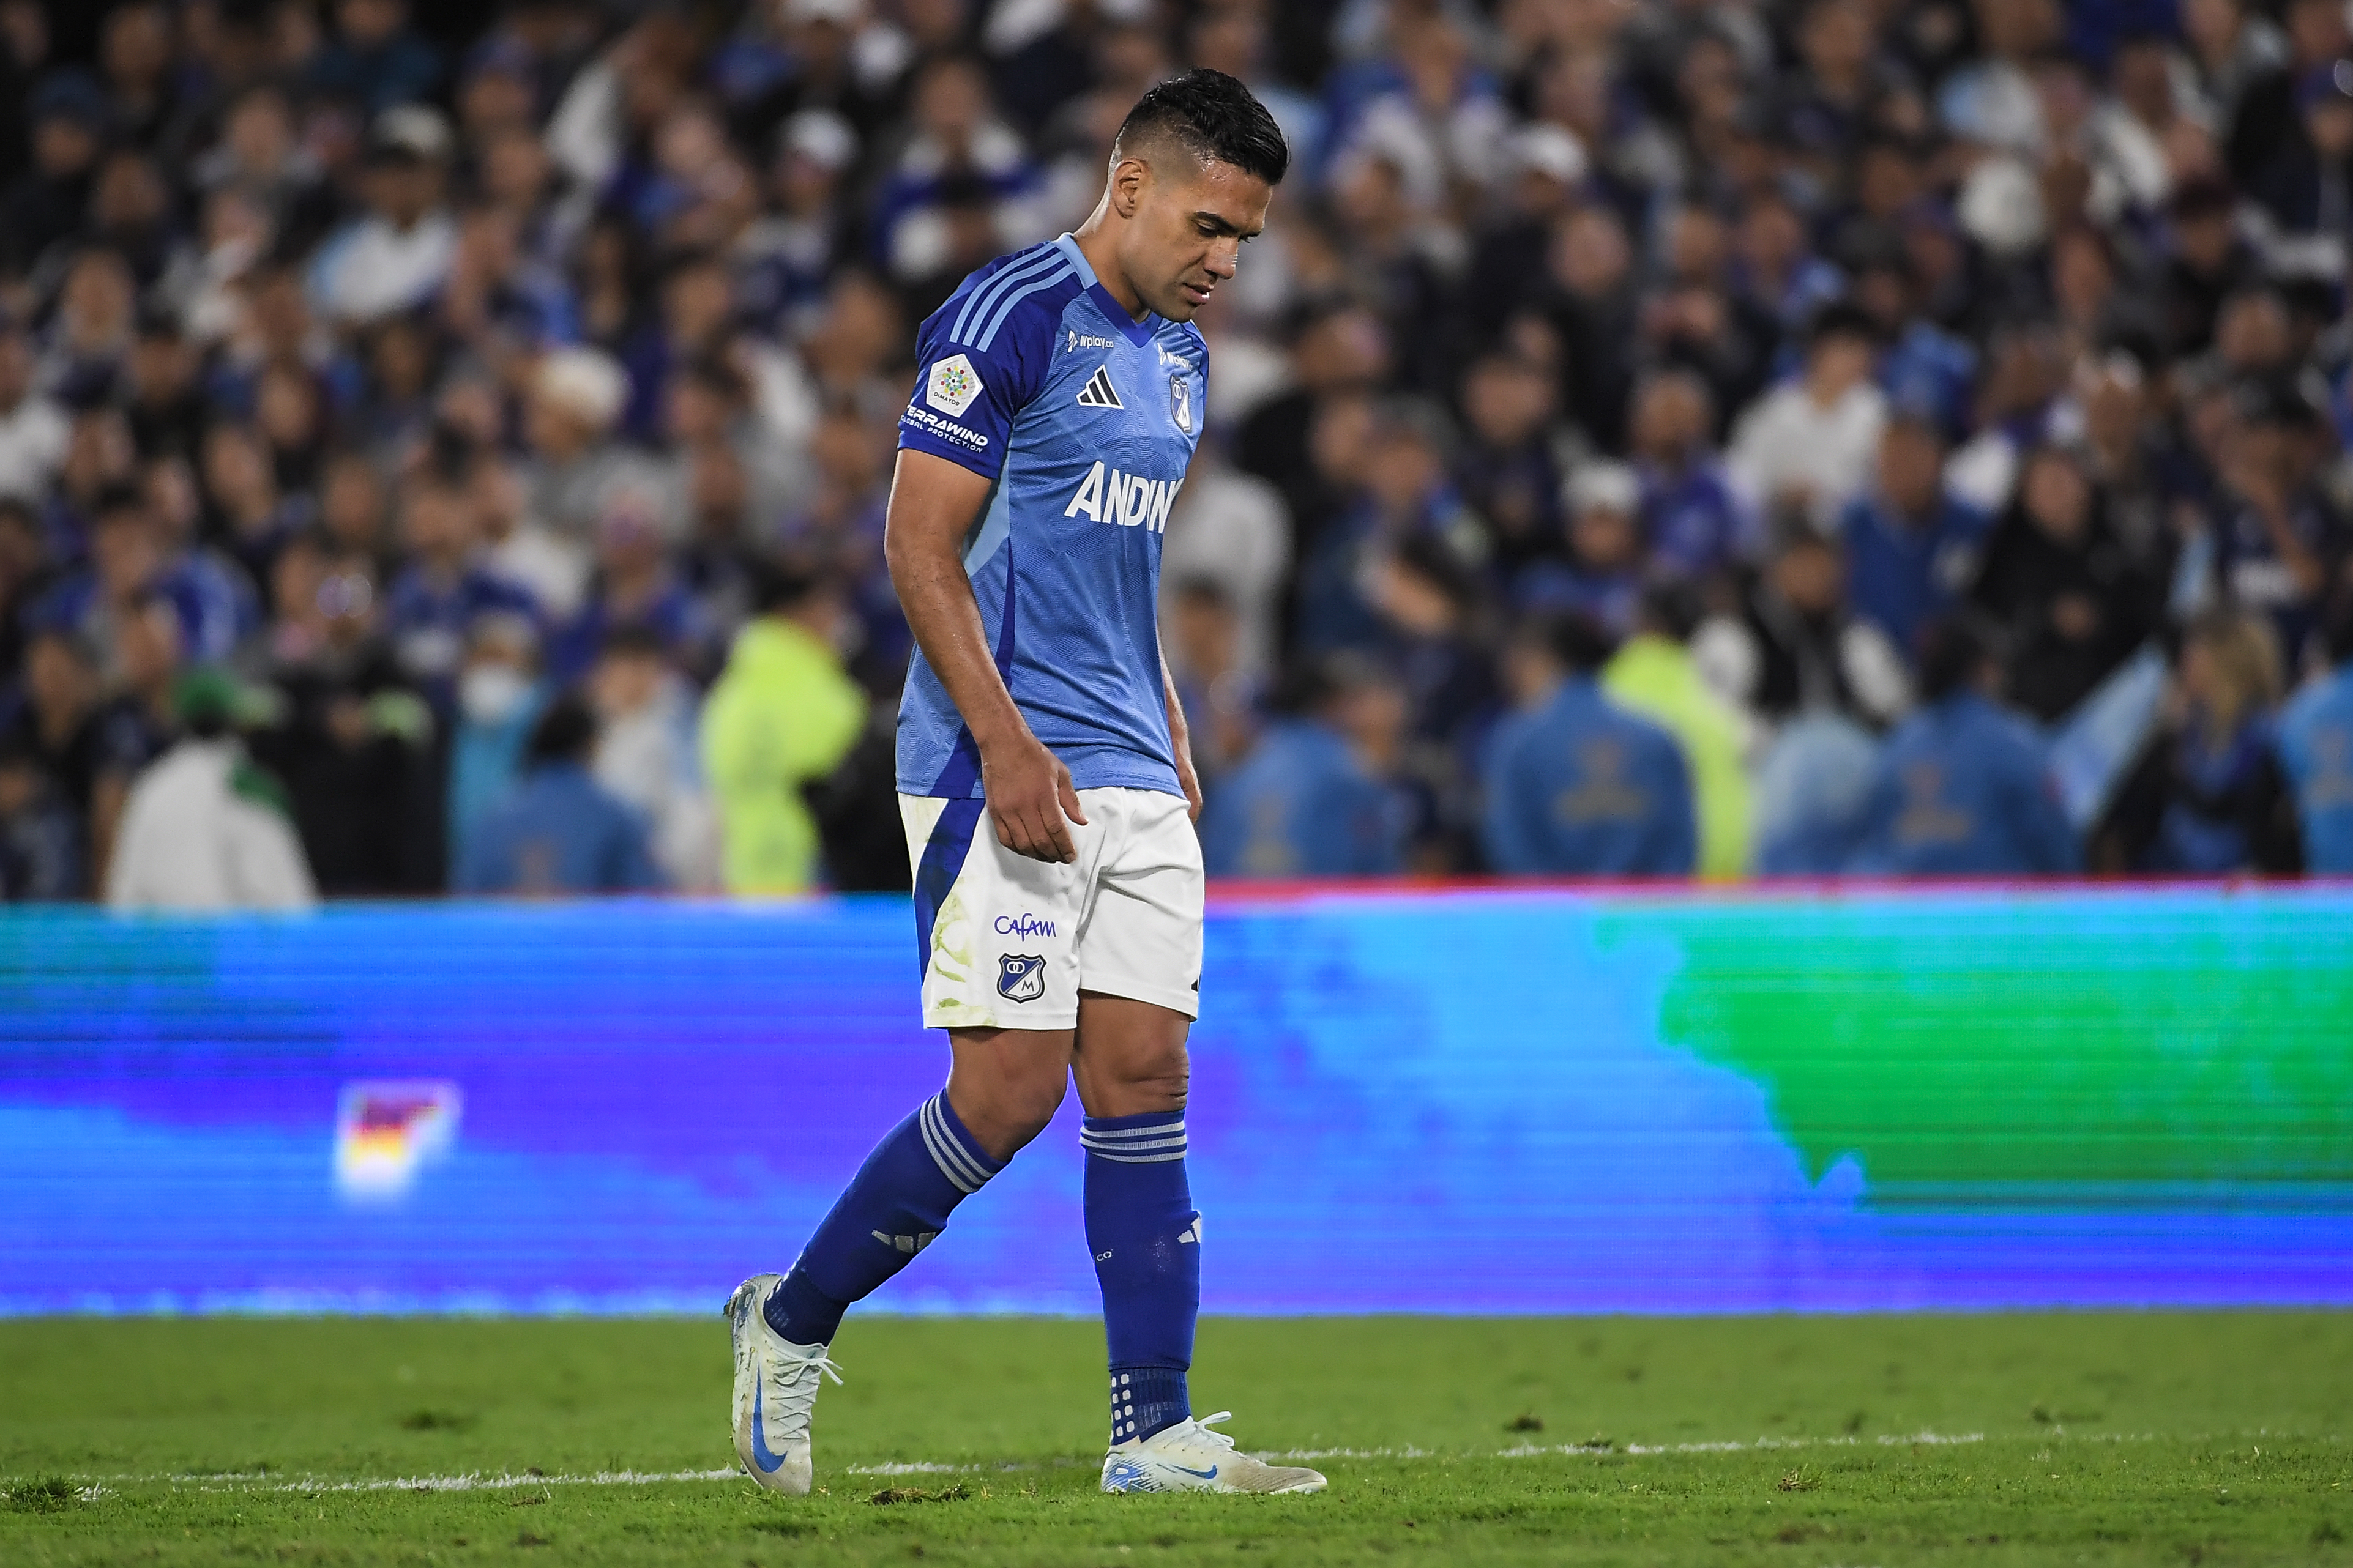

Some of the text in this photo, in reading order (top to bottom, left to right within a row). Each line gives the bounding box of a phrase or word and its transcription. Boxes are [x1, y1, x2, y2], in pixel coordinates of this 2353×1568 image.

[933, 392, 960, 407] DIMAYOR
[900, 415, 983, 453] GLOBAL PROTECTION
[1021, 980, 1034, 992] M
